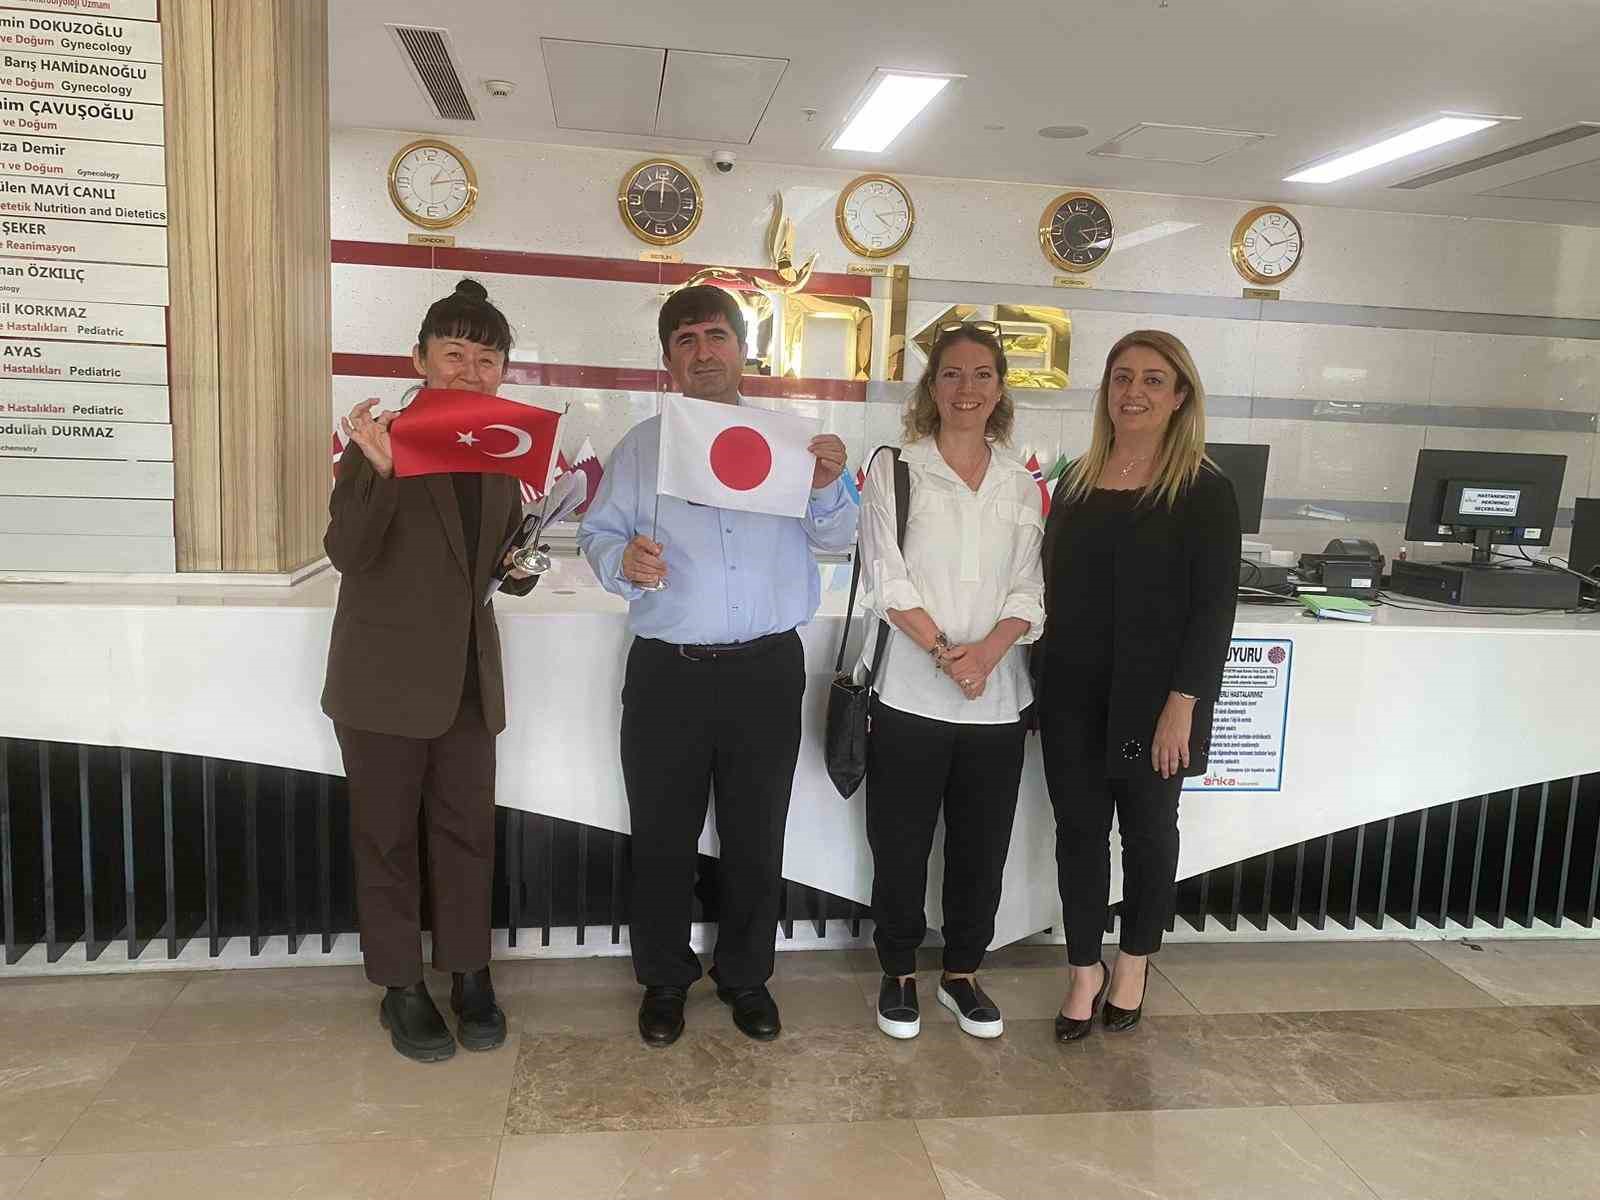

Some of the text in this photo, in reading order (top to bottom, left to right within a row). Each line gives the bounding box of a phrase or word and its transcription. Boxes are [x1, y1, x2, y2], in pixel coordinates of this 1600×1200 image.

[30, 19, 123, 38] DOKUZOĞLU
[16, 34, 54, 47] Doğum
[61, 38, 132, 55] Gynecology
[4, 56, 147, 80] Barış HAMİDANOĞLU
[15, 77, 54, 90] Doğum
[61, 81, 132, 97] Gynecology
[30, 100, 134, 121] ÇAVUŞOĞLU
[18, 119, 57, 130] Doğum
[22, 142, 66, 155] Demir
[24, 162, 64, 174] Doğum
[76, 169, 120, 180] Gynecology
[656, 168, 670, 180] 12
[31, 183, 69, 196] MAVİ
[73, 187, 115, 199] CANLI
[34, 202, 86, 214] Nutrition
[90, 207, 112, 216] and
[115, 208, 166, 219] Dietetics
[1076, 201, 1089, 212] 12
[1267, 215, 1280, 225] 12
[2, 222, 46, 235] ŞEKER
[655, 224, 667, 234] 6
[6, 240, 76, 254] Reanimasyon
[28, 264, 85, 283] ÖZKILIÇ
[1264, 264, 1272, 274] 6
[15, 304, 87, 318] KORKMAZ
[7, 322, 67, 333] Hastalıkları
[77, 325, 125, 337] Pediatric
[3, 346, 41, 358] AYAS
[3, 363, 121, 377] Hastalıkları Pediatric
[7, 403, 65, 413] Hastalıkları
[72, 405, 124, 415] Pediatric
[52, 426, 114, 438] DURMAZ
